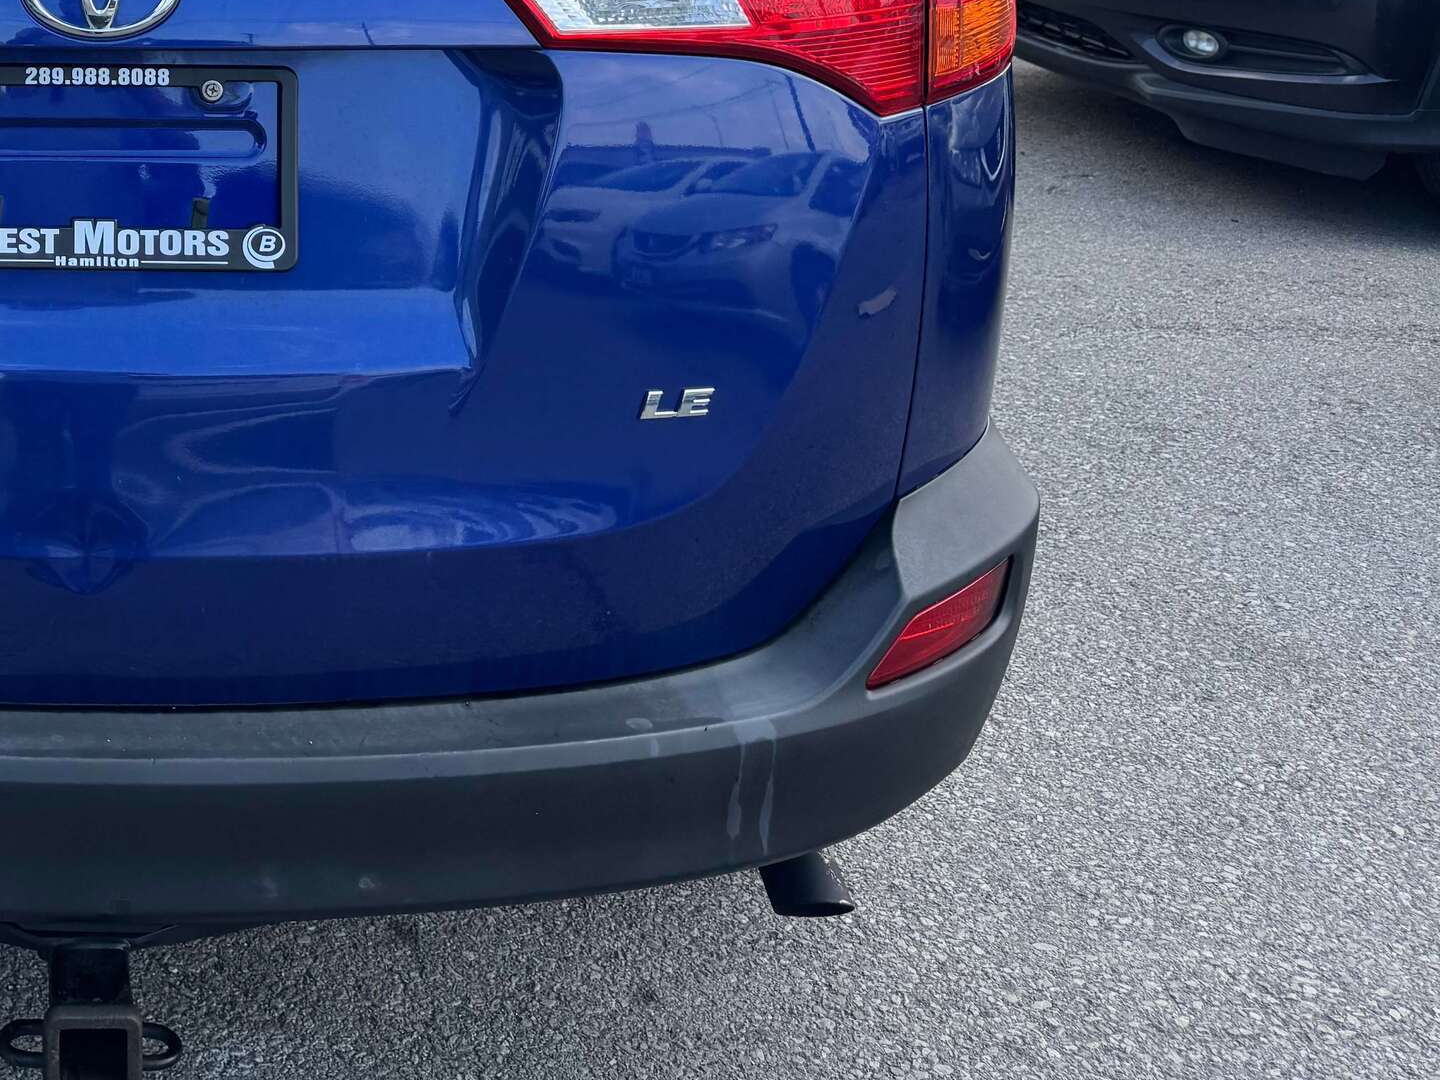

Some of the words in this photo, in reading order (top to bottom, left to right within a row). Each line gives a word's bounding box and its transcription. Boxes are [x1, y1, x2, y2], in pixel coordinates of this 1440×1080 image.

[25, 67, 170, 86] 289.988.8088
[55, 255, 139, 267] Hamilton
[639, 387, 716, 420] LE
